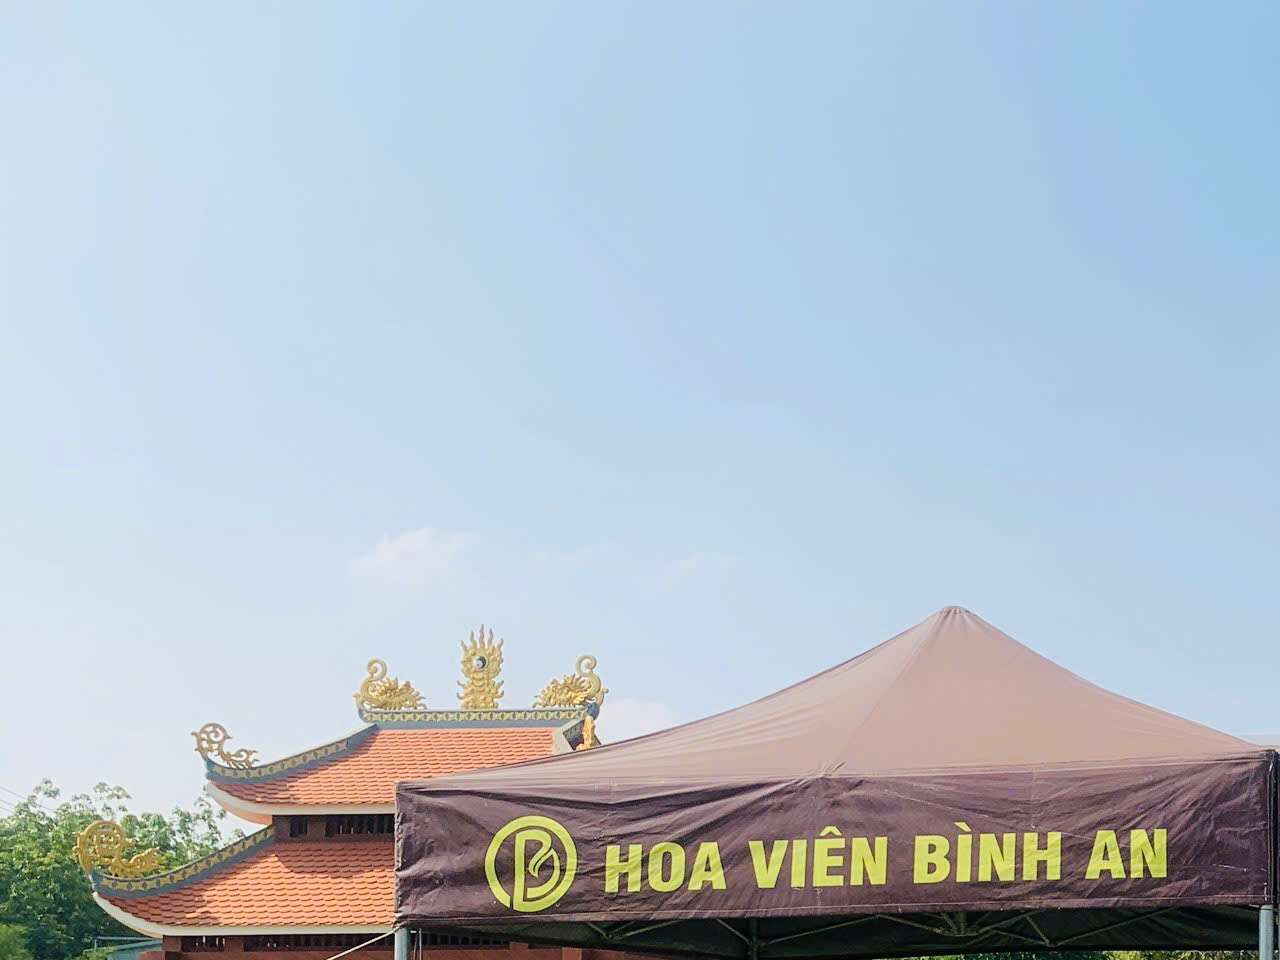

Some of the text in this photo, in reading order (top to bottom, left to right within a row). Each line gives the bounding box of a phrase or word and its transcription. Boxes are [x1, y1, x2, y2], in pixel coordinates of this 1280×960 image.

[605, 821, 1167, 893] HOA VIÊN BÌNH AN
